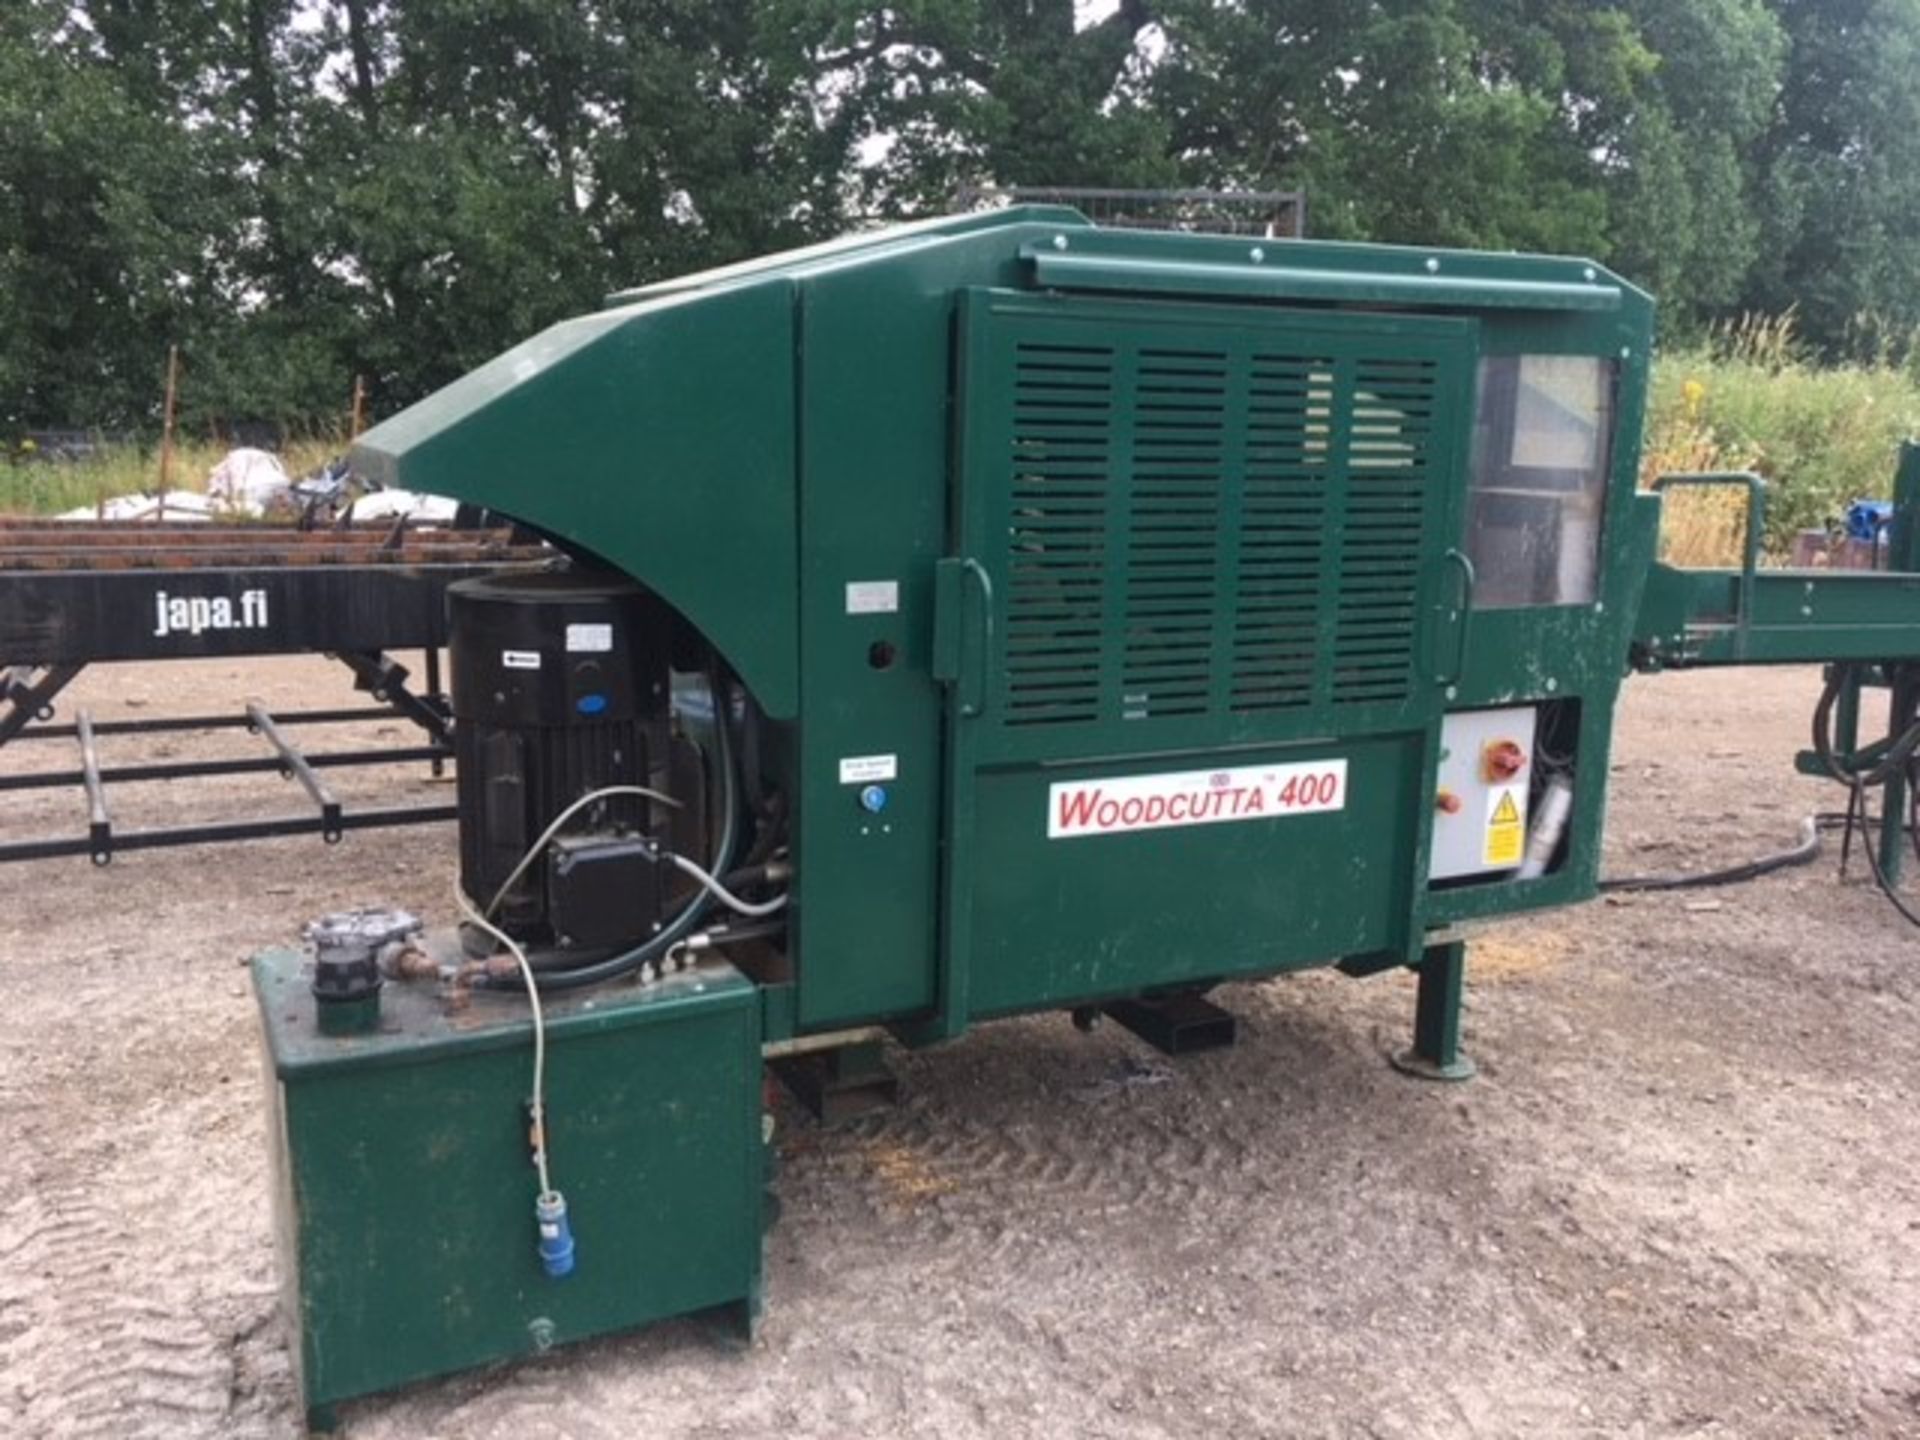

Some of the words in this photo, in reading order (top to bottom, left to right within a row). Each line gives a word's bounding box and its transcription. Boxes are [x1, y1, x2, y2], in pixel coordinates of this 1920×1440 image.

[153, 589, 267, 636] japa.fi
[1059, 785, 1263, 828] WOODCUTTA
[1278, 772, 1337, 806] 400
